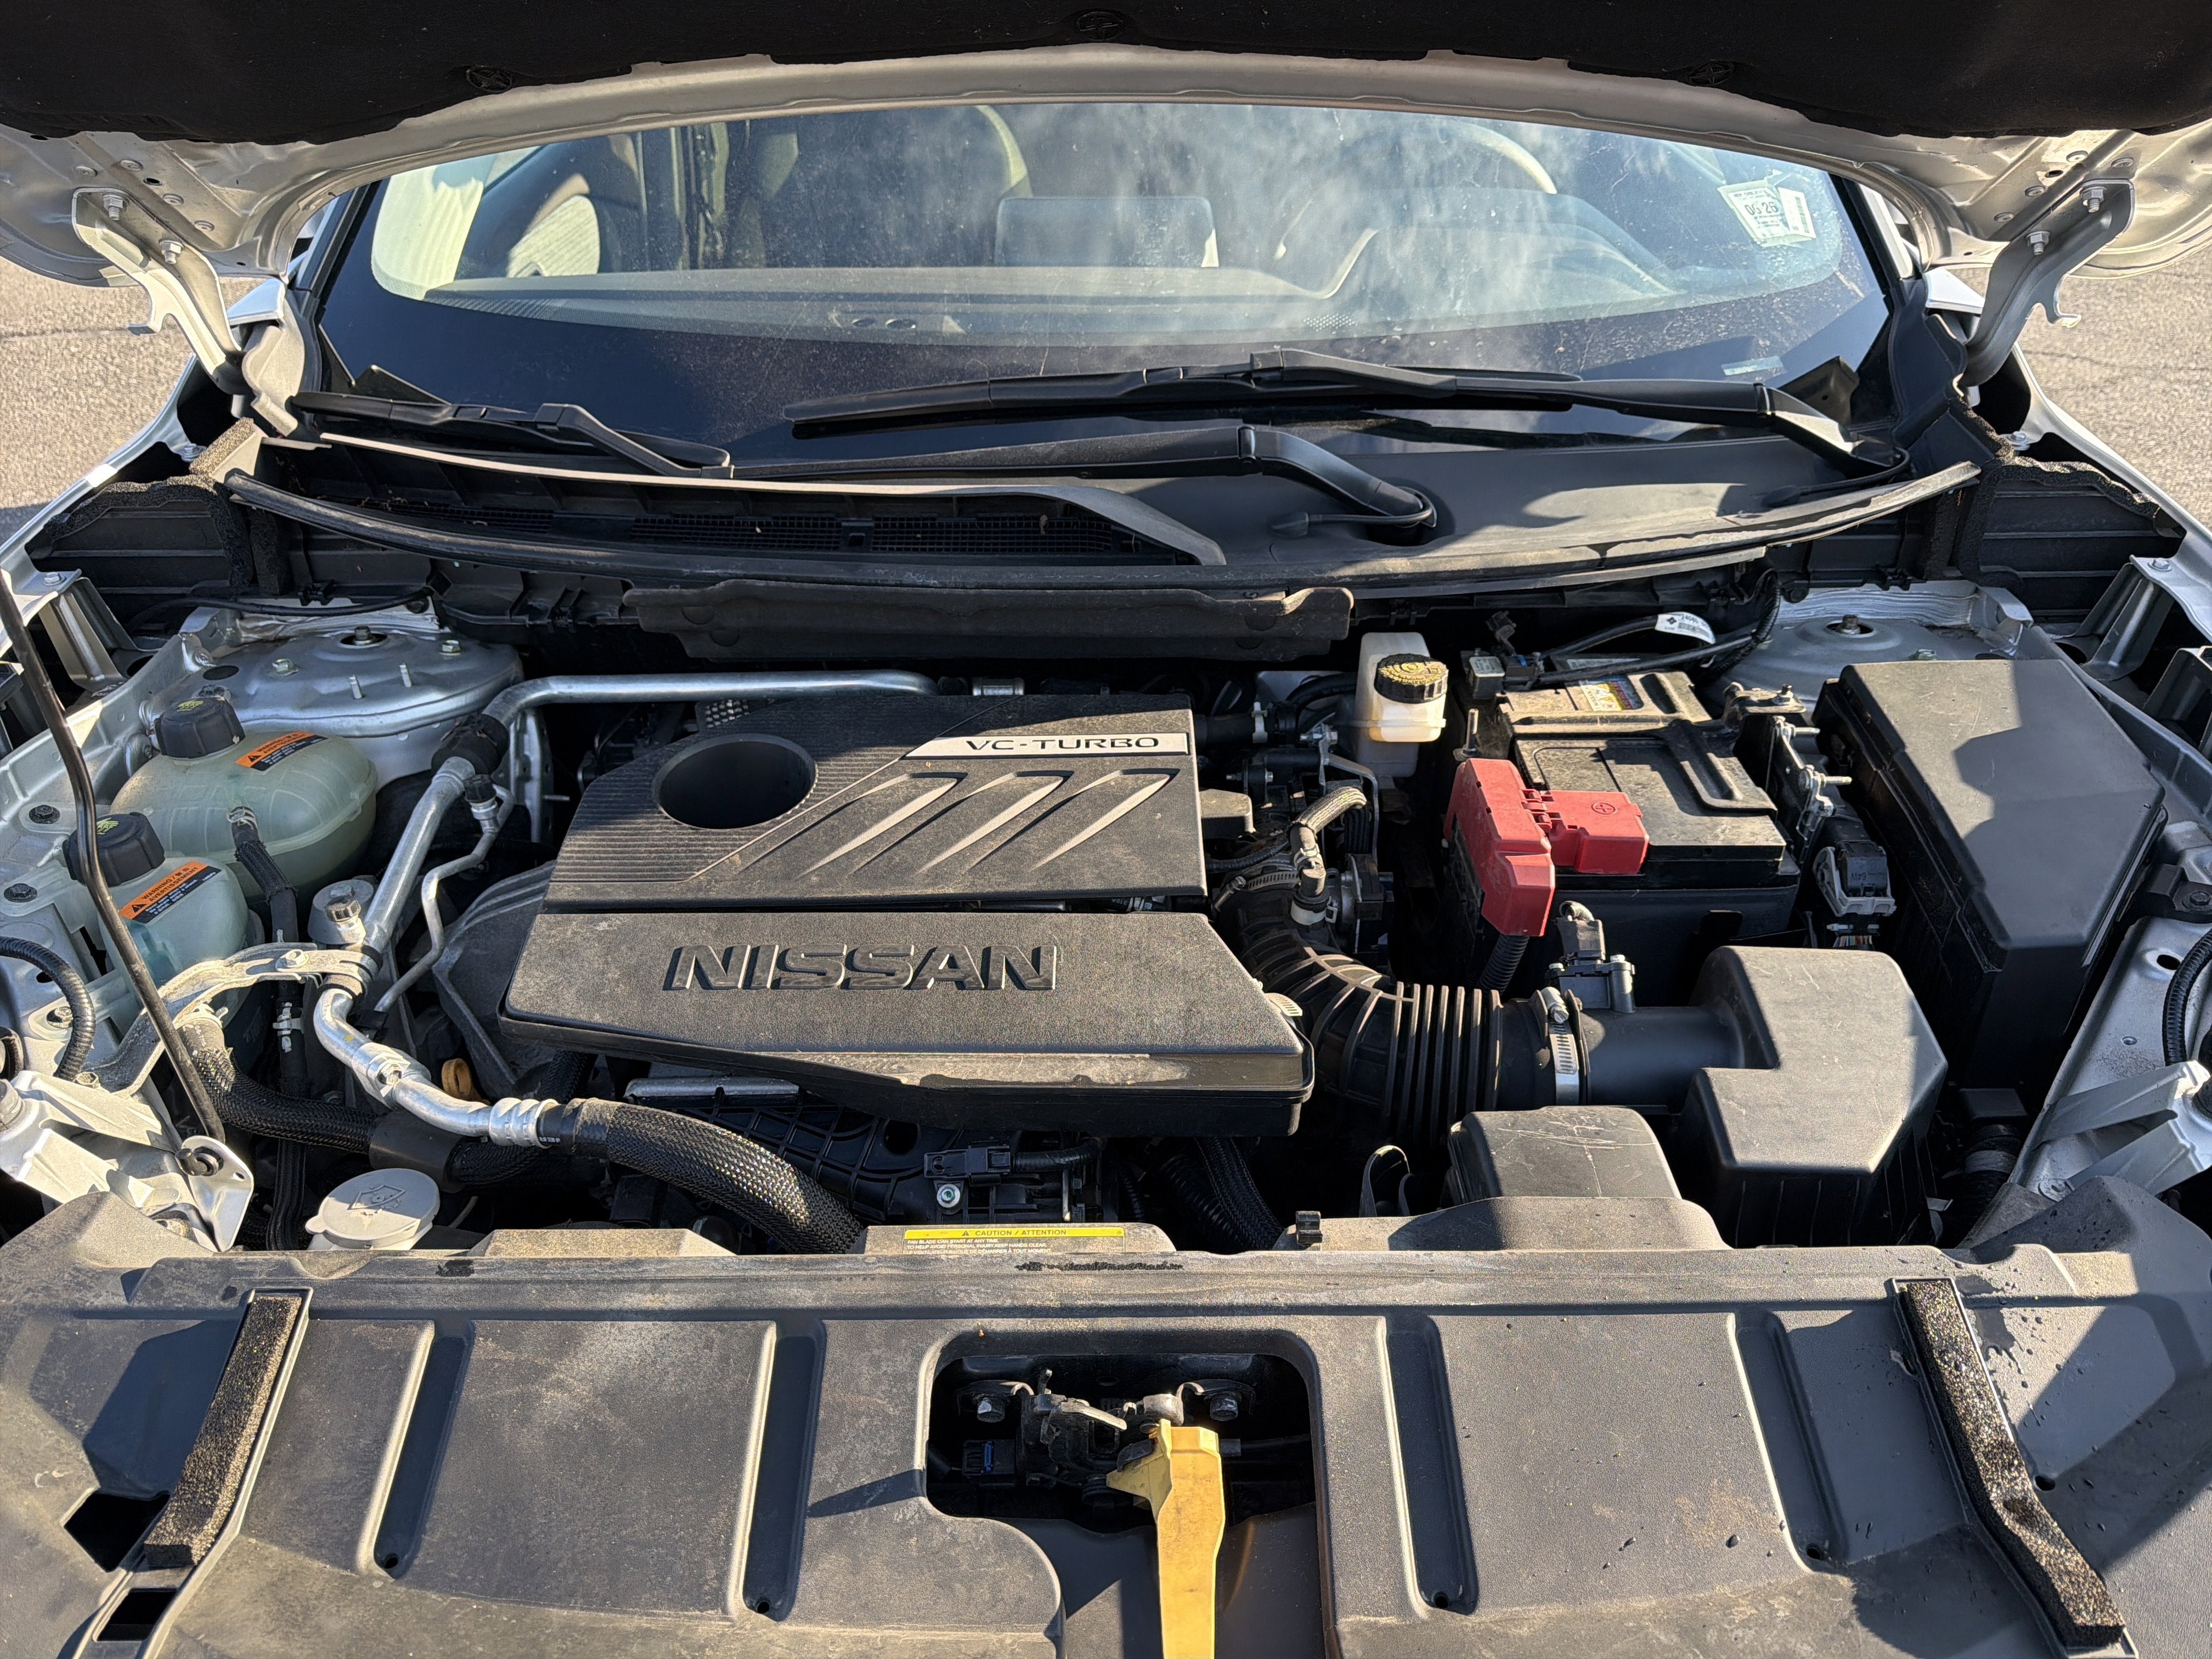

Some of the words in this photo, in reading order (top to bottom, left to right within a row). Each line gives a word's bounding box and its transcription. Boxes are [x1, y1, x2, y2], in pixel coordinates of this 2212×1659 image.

[966, 737, 1159, 751] VC-TURBO
[142, 878, 173, 900] WARNING
[662, 944, 1057, 991] NISSAN
